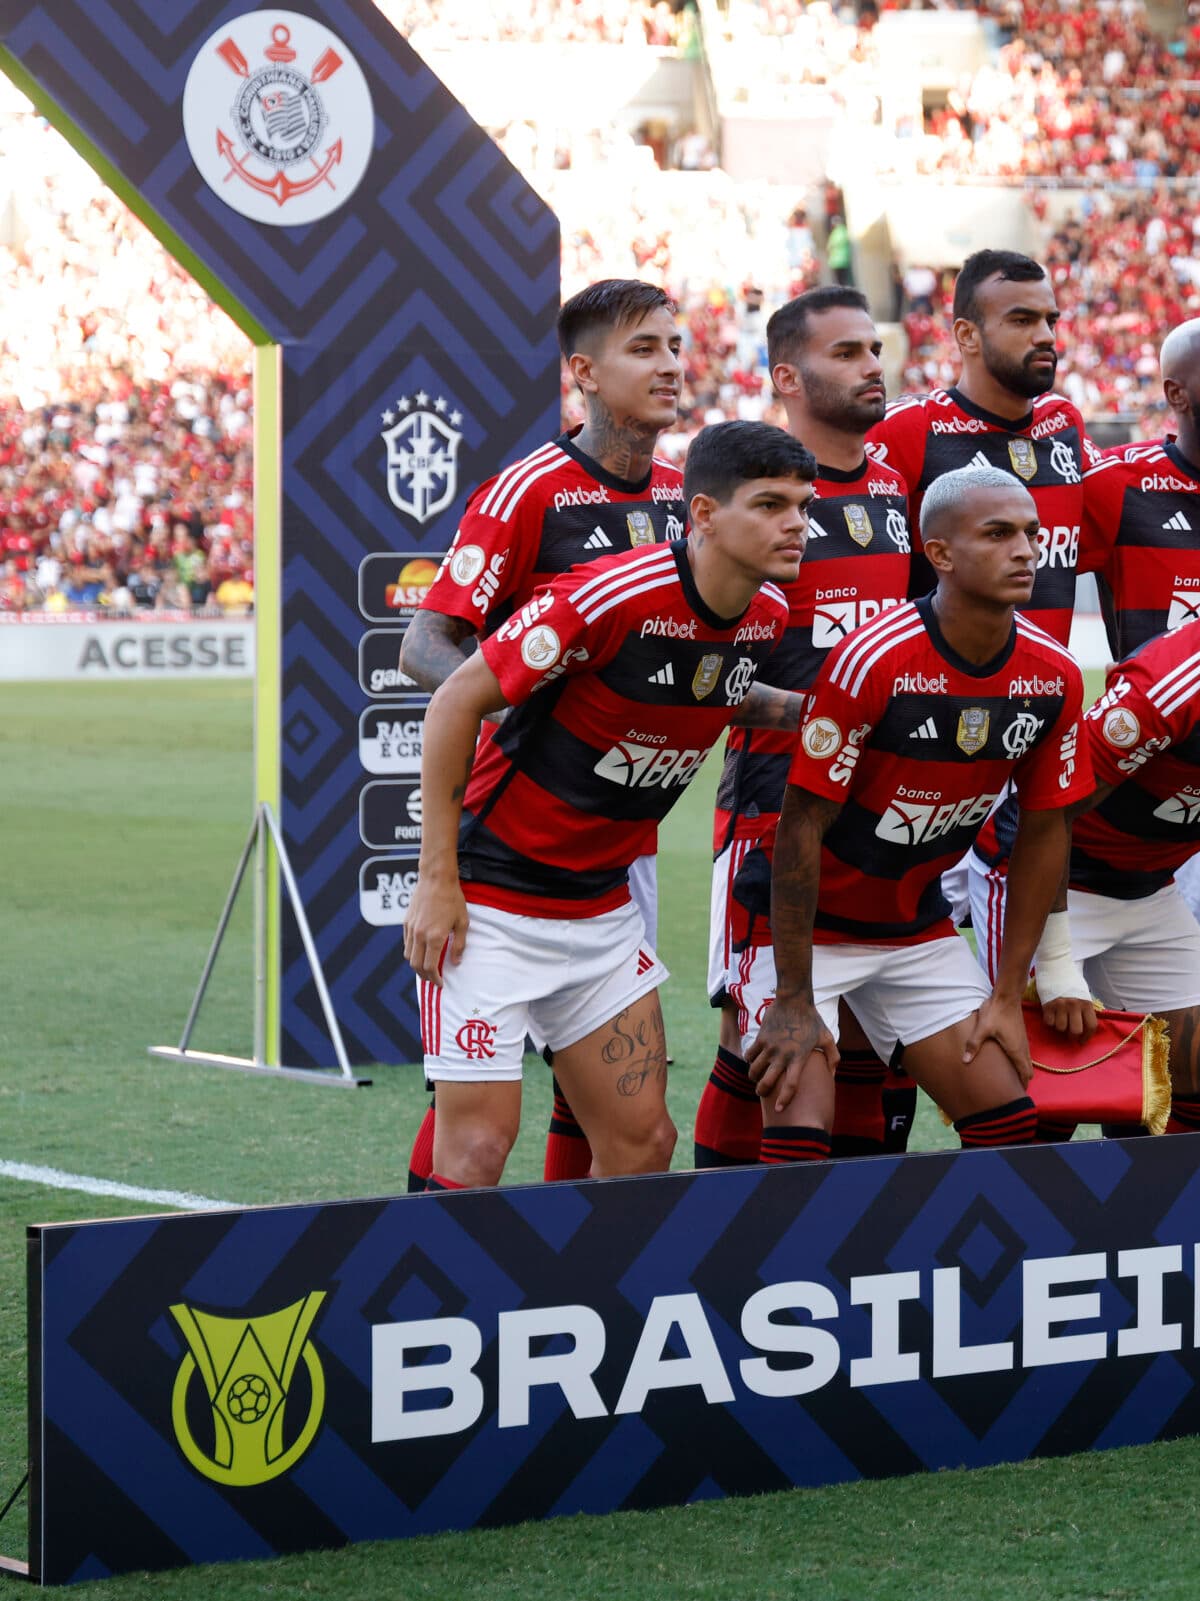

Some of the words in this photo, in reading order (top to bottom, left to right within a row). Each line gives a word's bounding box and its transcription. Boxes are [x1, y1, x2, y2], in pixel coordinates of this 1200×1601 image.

[931, 416, 988, 436] pixbet
[1031, 411, 1069, 440] pixbet
[554, 485, 611, 512] pixbet
[815, 586, 858, 600] banco
[641, 616, 698, 639] pixbet
[734, 619, 777, 646] pixbet
[79, 635, 246, 670] ACESSE
[893, 672, 948, 696] pixbet
[1009, 675, 1065, 699] pixbet
[626, 728, 668, 744] banco
[896, 784, 942, 800] banco
[922, 793, 1001, 843] BRB
